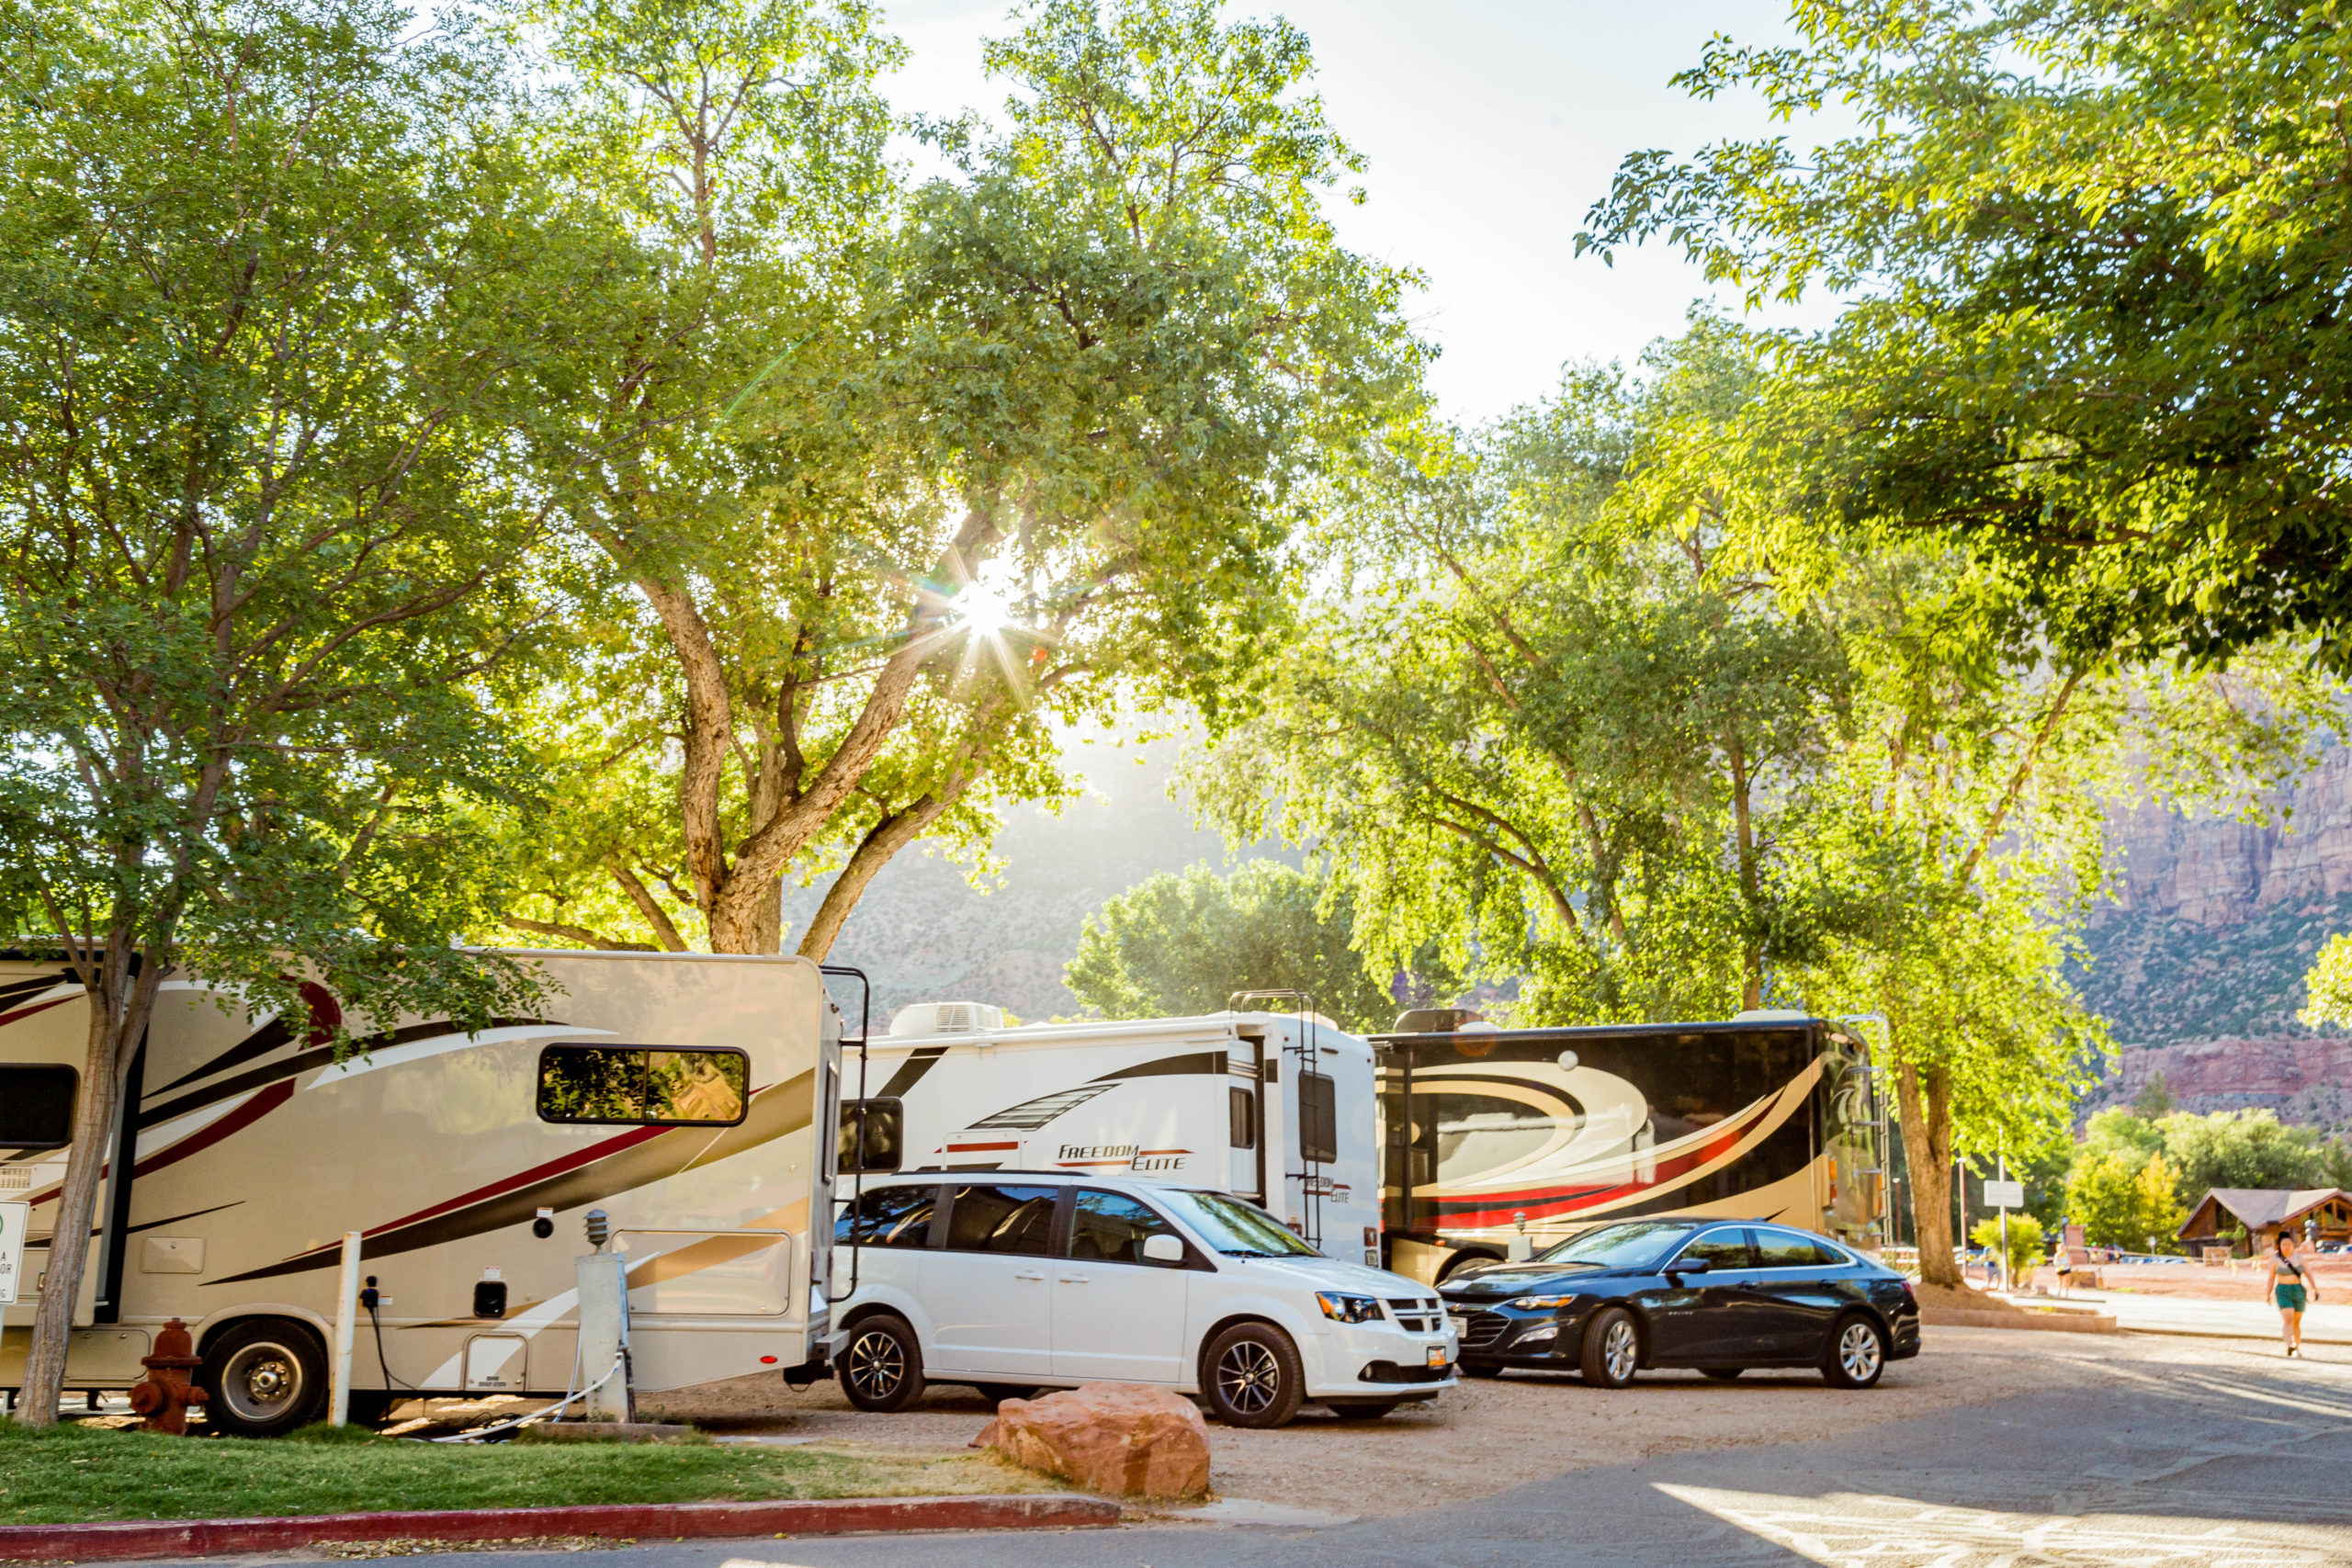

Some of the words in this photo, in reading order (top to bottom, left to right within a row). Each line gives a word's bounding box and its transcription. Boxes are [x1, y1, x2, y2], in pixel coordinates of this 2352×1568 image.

[1058, 1144, 1140, 1159] FREEDOM
[1131, 1156, 1187, 1171] ELITE
[1305, 1177, 1334, 1188] REDOM
[1330, 1188, 1349, 1203] ELITE
